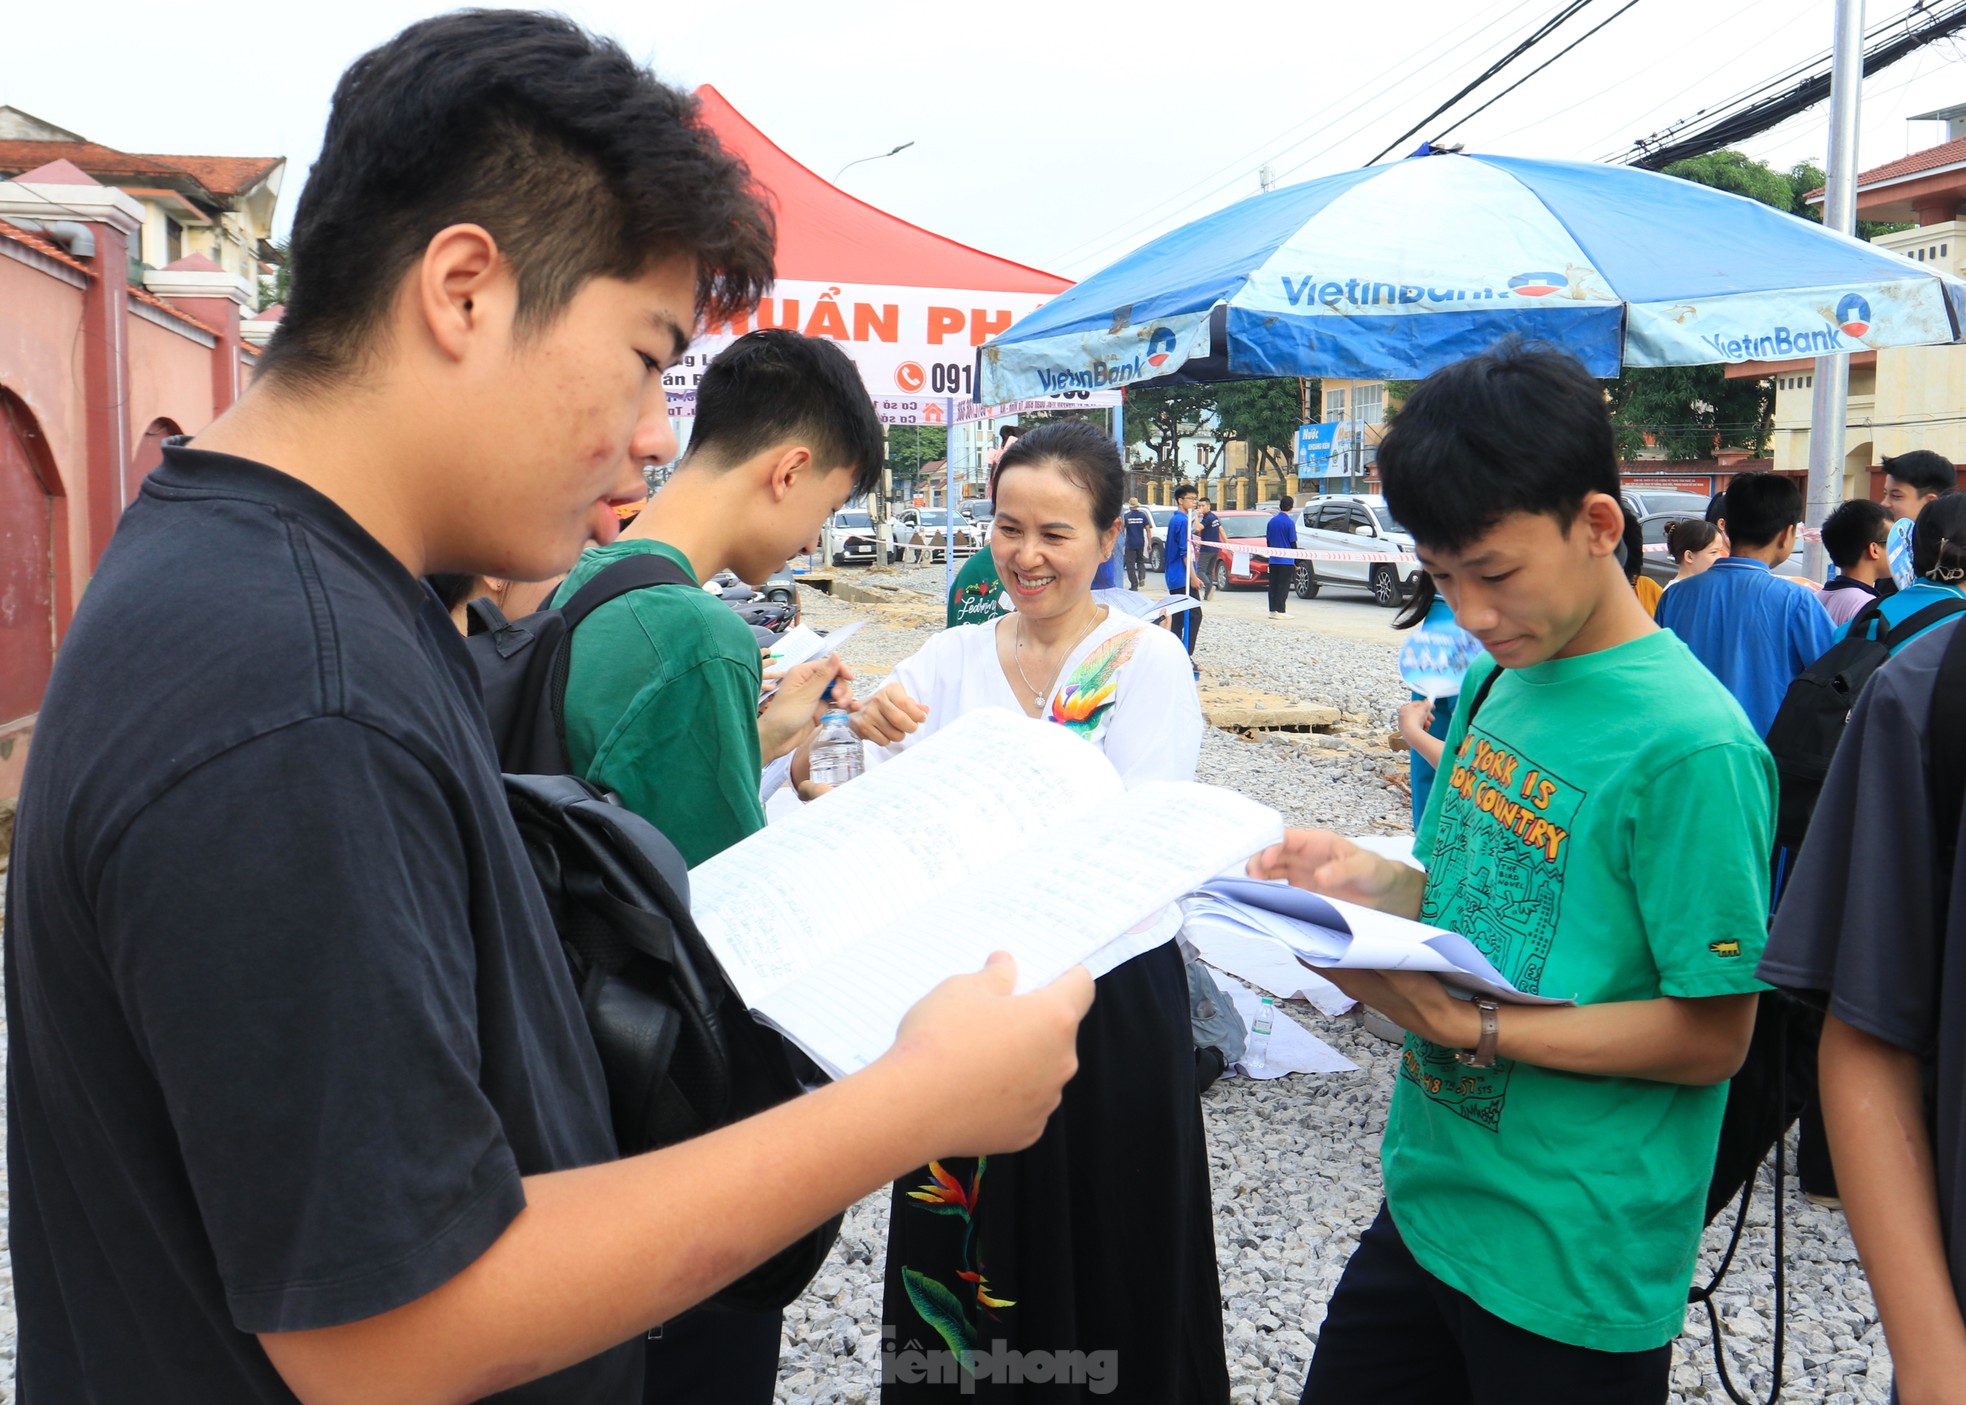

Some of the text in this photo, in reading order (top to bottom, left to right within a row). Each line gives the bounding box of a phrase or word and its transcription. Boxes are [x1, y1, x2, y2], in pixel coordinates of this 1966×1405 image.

[1281, 275, 1510, 306] VietinBan
[1701, 322, 1845, 358] VietinBank
[931, 363, 972, 394] 091
[1037, 356, 1146, 392] VietinBank
[1470, 738, 1519, 790] YORK
[1520, 769, 1557, 810] IS
[1475, 780, 1569, 863] COUNTRY
